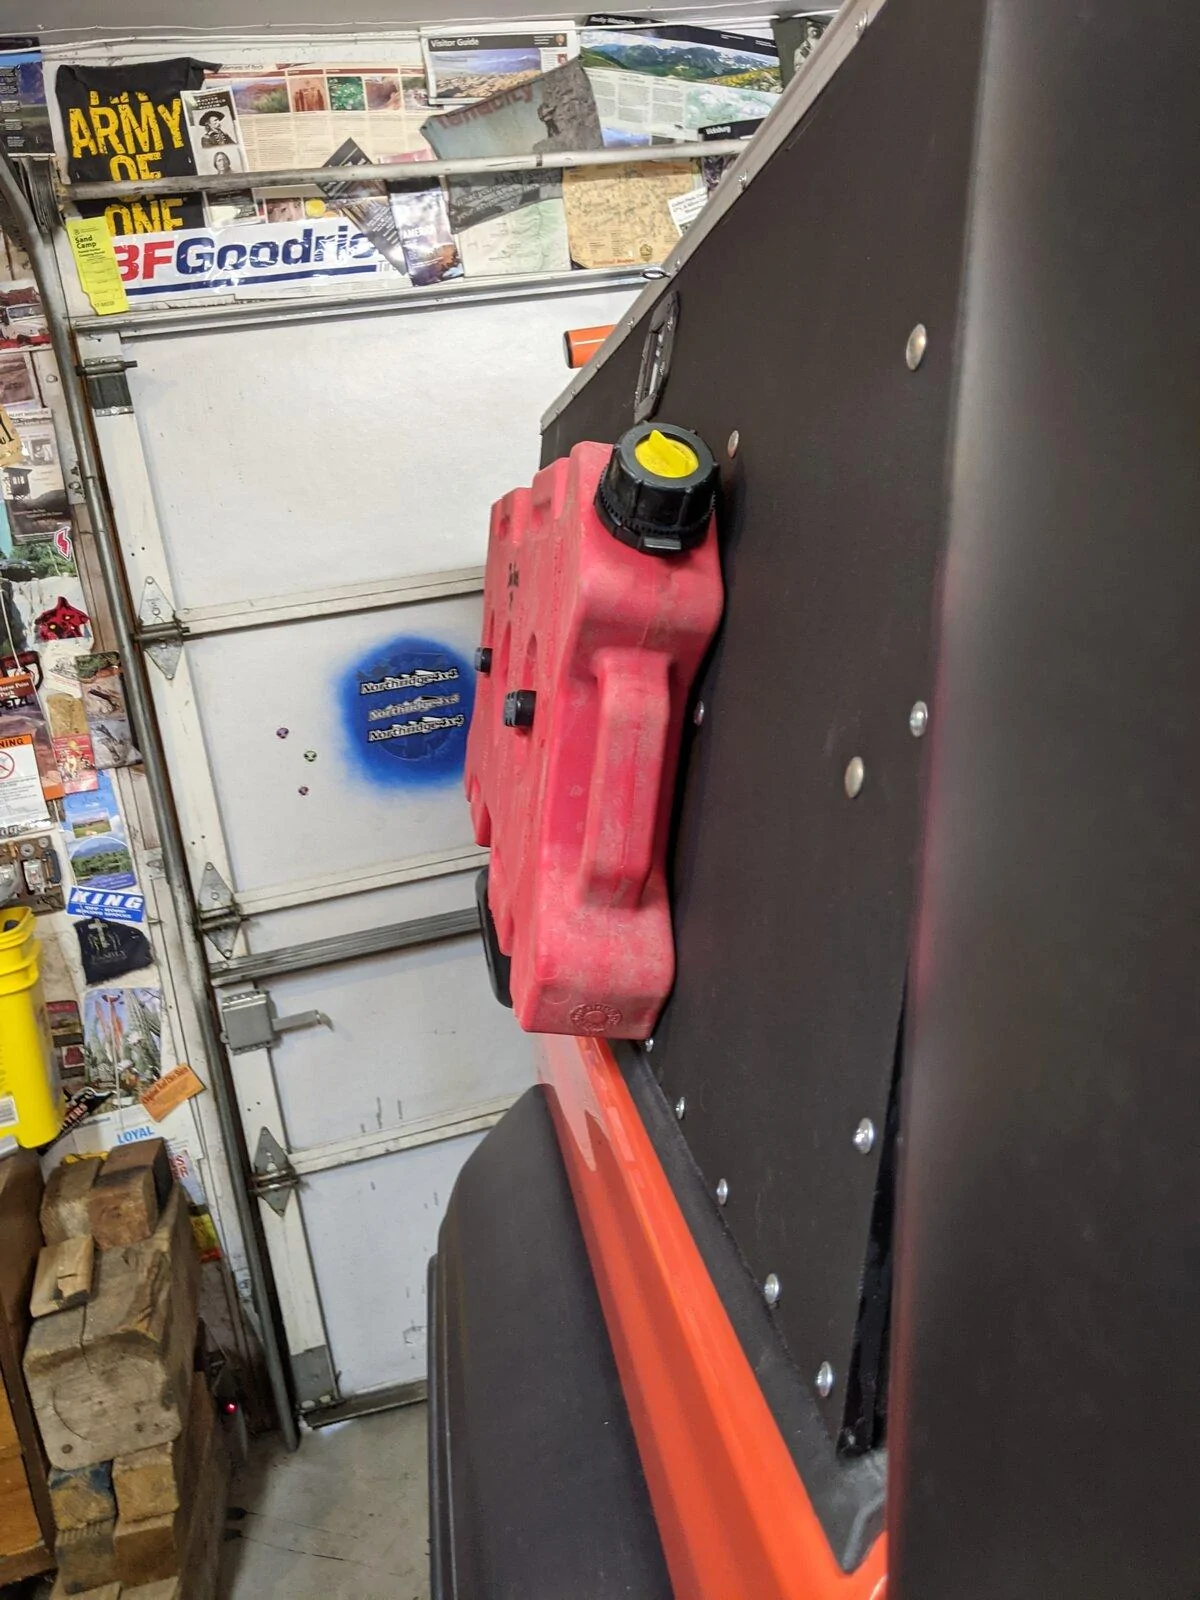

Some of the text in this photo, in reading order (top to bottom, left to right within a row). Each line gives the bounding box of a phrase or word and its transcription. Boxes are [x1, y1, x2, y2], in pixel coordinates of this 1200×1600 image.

[430, 37, 480, 47] Visitor Guide
[69, 99, 184, 158] ARMY
[109, 152, 162, 192] OF
[105, 198, 183, 236] ONE
[75, 235, 93, 244] Sand
[77, 241, 97, 250] Camp
[71, 889, 143, 910] KING
[116, 1125, 155, 1145] LOYAL
